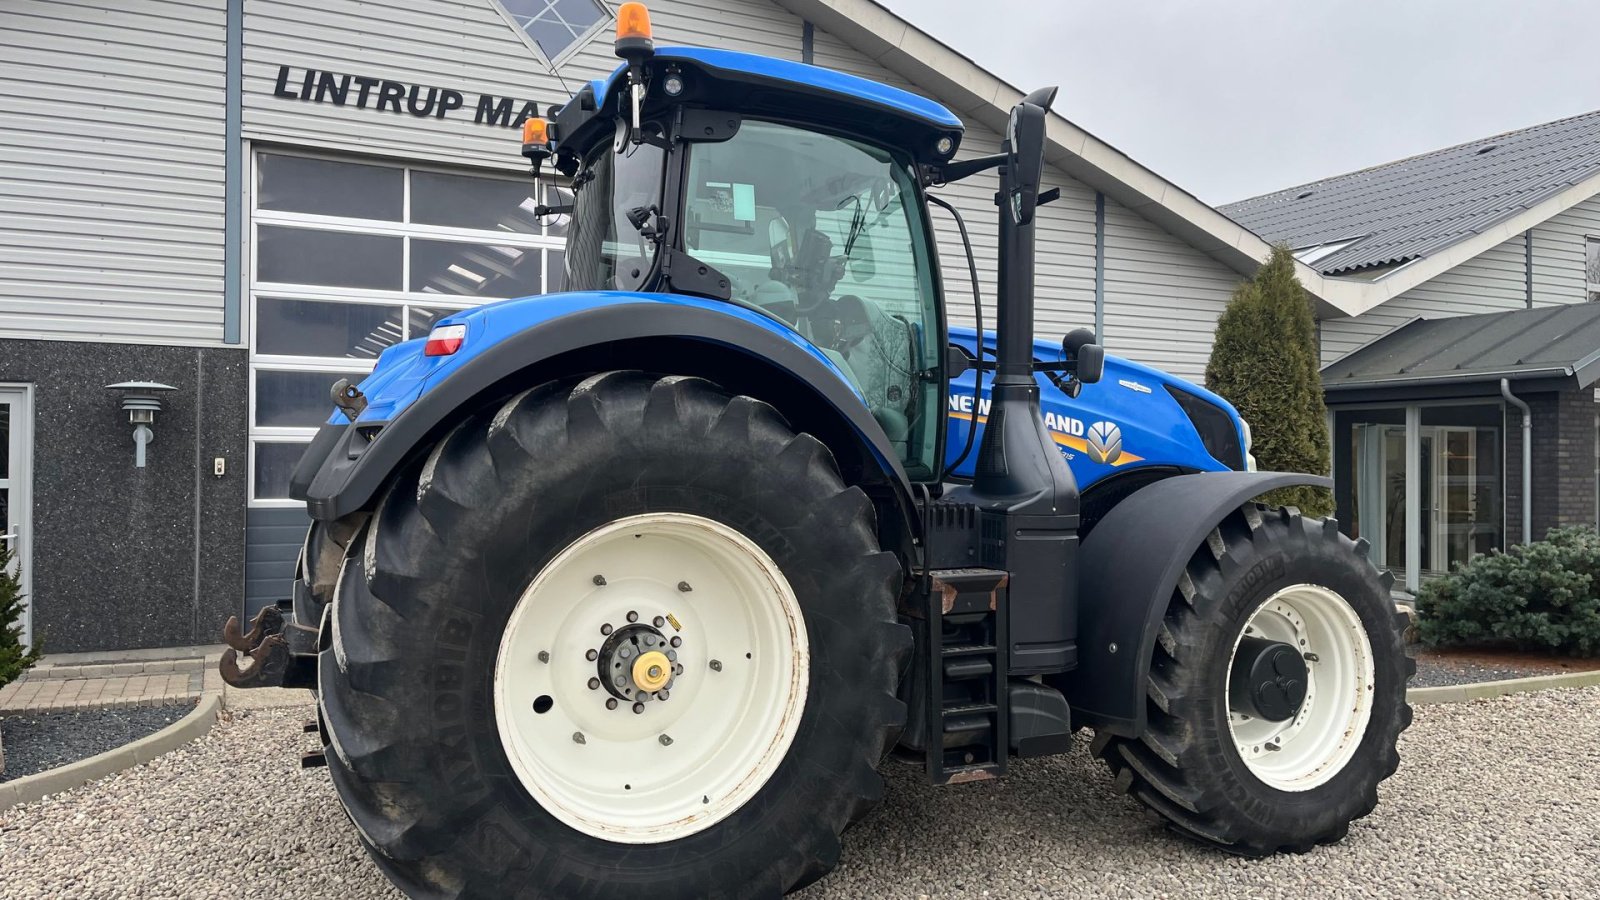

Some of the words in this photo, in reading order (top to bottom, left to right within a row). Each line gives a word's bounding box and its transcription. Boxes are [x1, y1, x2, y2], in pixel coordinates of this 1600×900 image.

[274, 65, 464, 119] LINTRUP
[948, 394, 992, 416] NEW
[1044, 411, 1084, 437] AND
